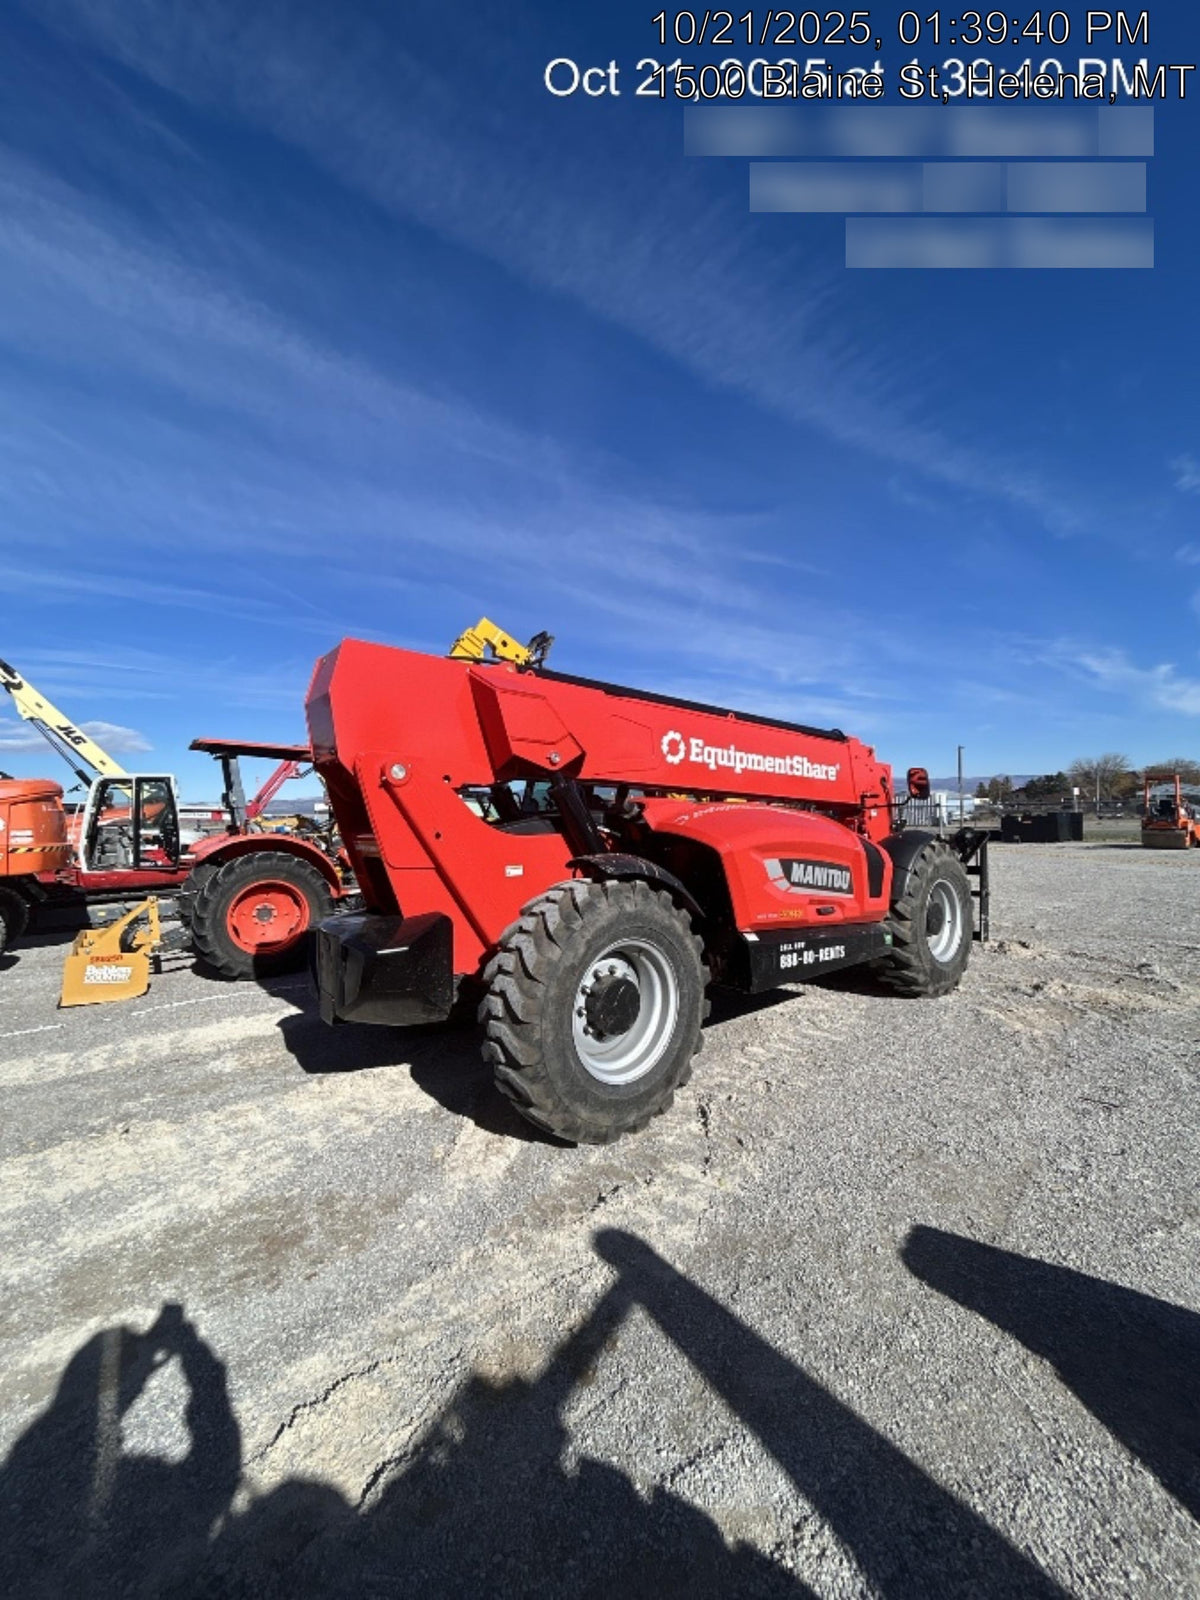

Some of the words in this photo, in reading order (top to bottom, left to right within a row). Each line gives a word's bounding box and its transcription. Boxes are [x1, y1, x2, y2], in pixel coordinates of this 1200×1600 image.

[56, 725, 87, 745] JLG
[689, 738, 837, 781] EquipmentShare
[790, 862, 850, 890] MANITOU
